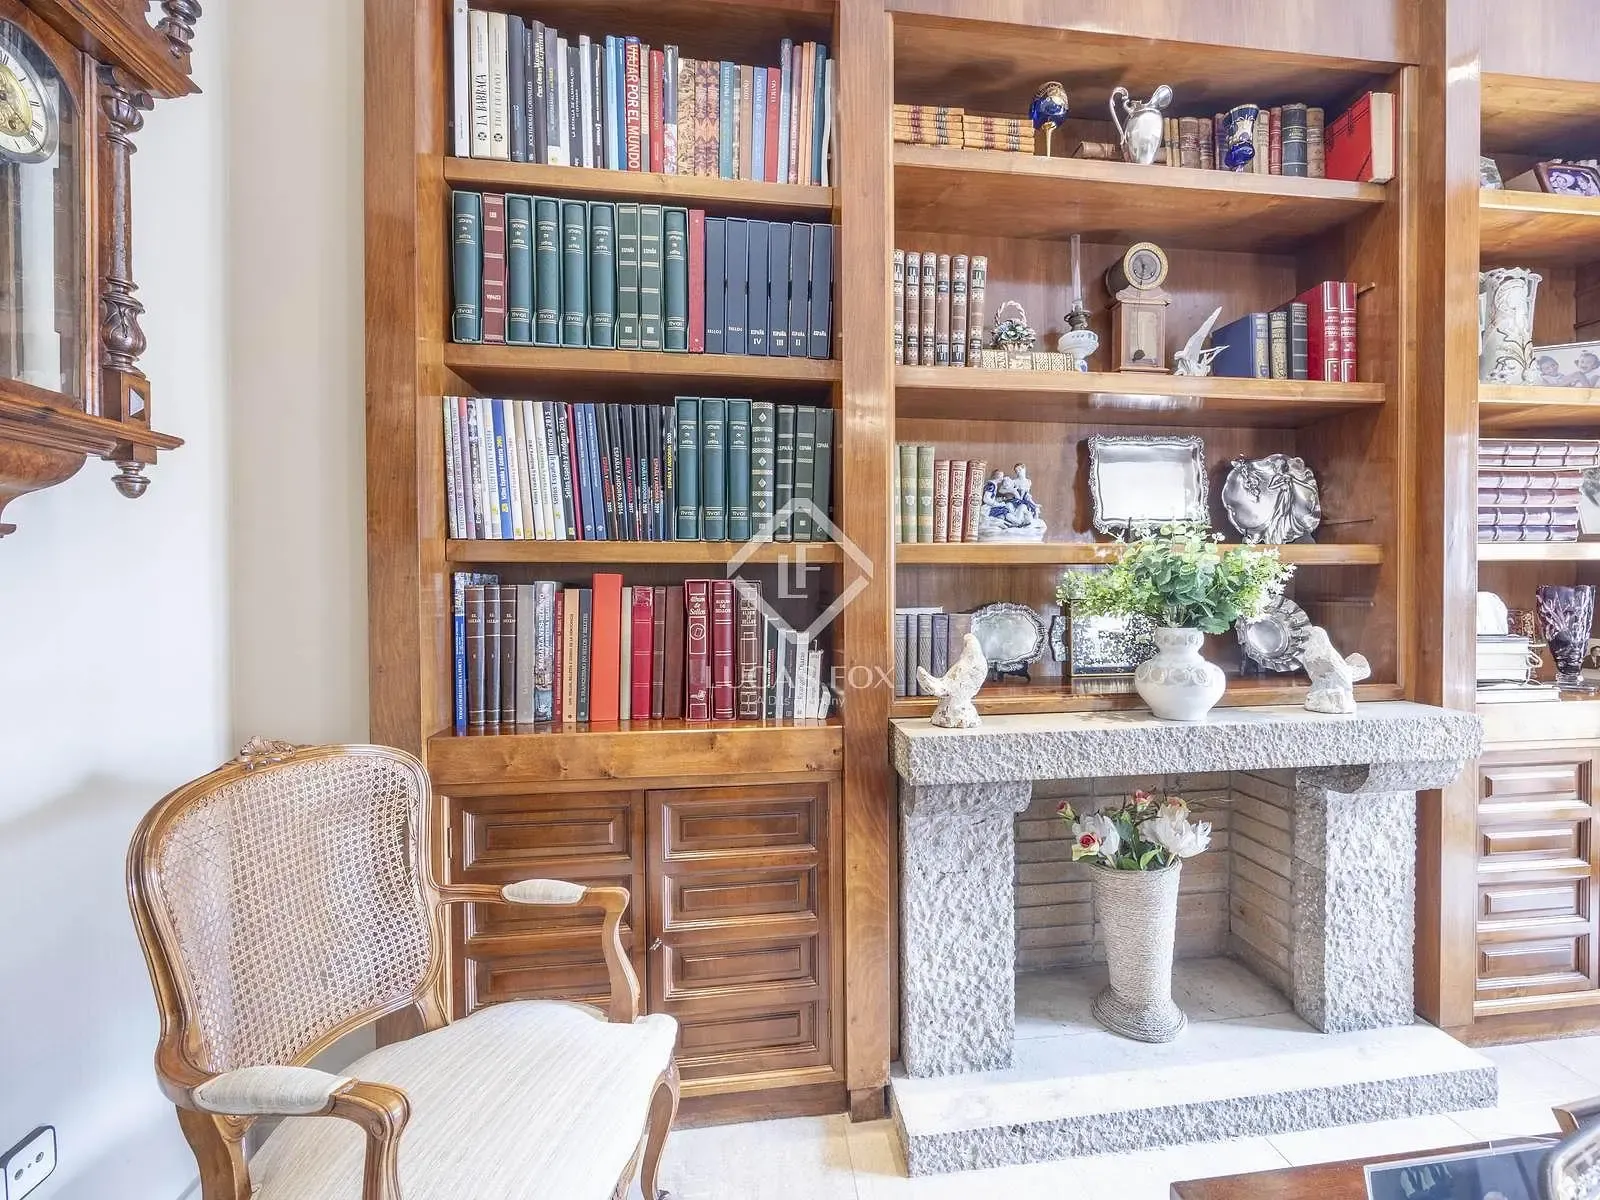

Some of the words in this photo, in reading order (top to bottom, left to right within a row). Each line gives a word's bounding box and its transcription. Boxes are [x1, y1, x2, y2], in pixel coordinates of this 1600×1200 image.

[626, 44, 639, 82] VIAJAR
[476, 73, 488, 110] BARRACA
[626, 84, 639, 109] POR
[476, 114, 488, 126] LA
[627, 110, 640, 124] EL
[628, 125, 640, 168] MUNDO
[753, 338, 762, 346] IV
[795, 338, 801, 346] II
